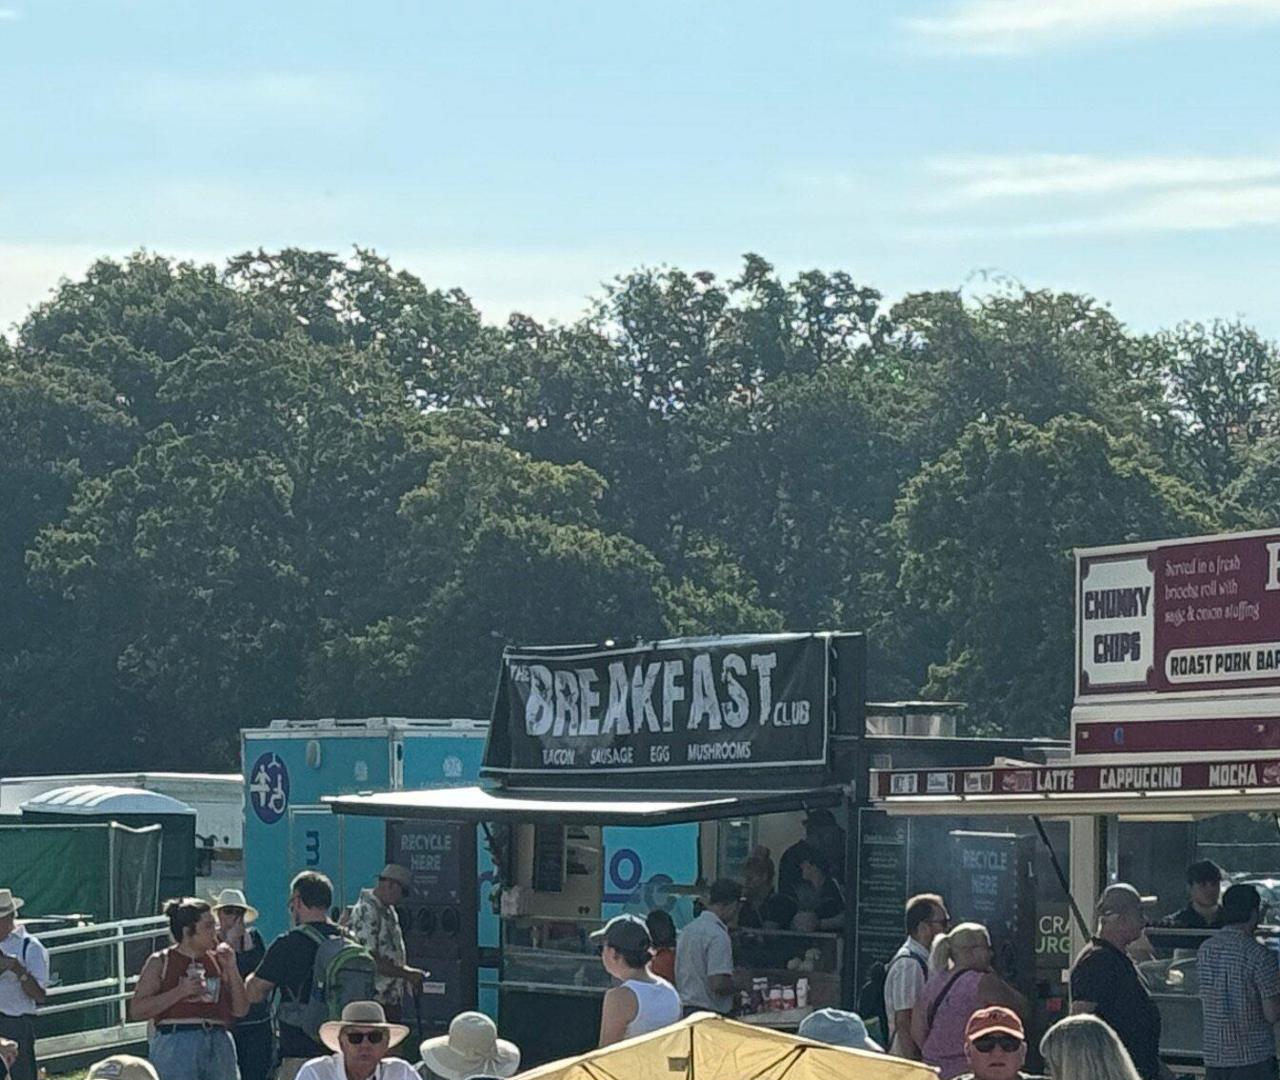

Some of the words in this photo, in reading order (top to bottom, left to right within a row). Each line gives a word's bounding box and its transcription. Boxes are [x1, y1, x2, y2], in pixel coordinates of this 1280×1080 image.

[1085, 586, 1151, 620] CHUNKY
[1093, 631, 1141, 664] CHIPS
[1170, 653, 1212, 676] ROAST
[1215, 651, 1252, 673] PORK
[524, 652, 777, 737] BREAKFAST
[773, 700, 812, 727] CLUB
[589, 746, 635, 766] SAUSAGE
[649, 745, 671, 763] EGG
[687, 741, 752, 761] MUSHROOMS
[1036, 769, 1075, 790] LATTE
[1100, 766, 1182, 790] CAPPUCCINO
[1209, 763, 1258, 787] MOCHA
[400, 833, 452, 850] RECYCLE
[410, 854, 441, 870] HERE
